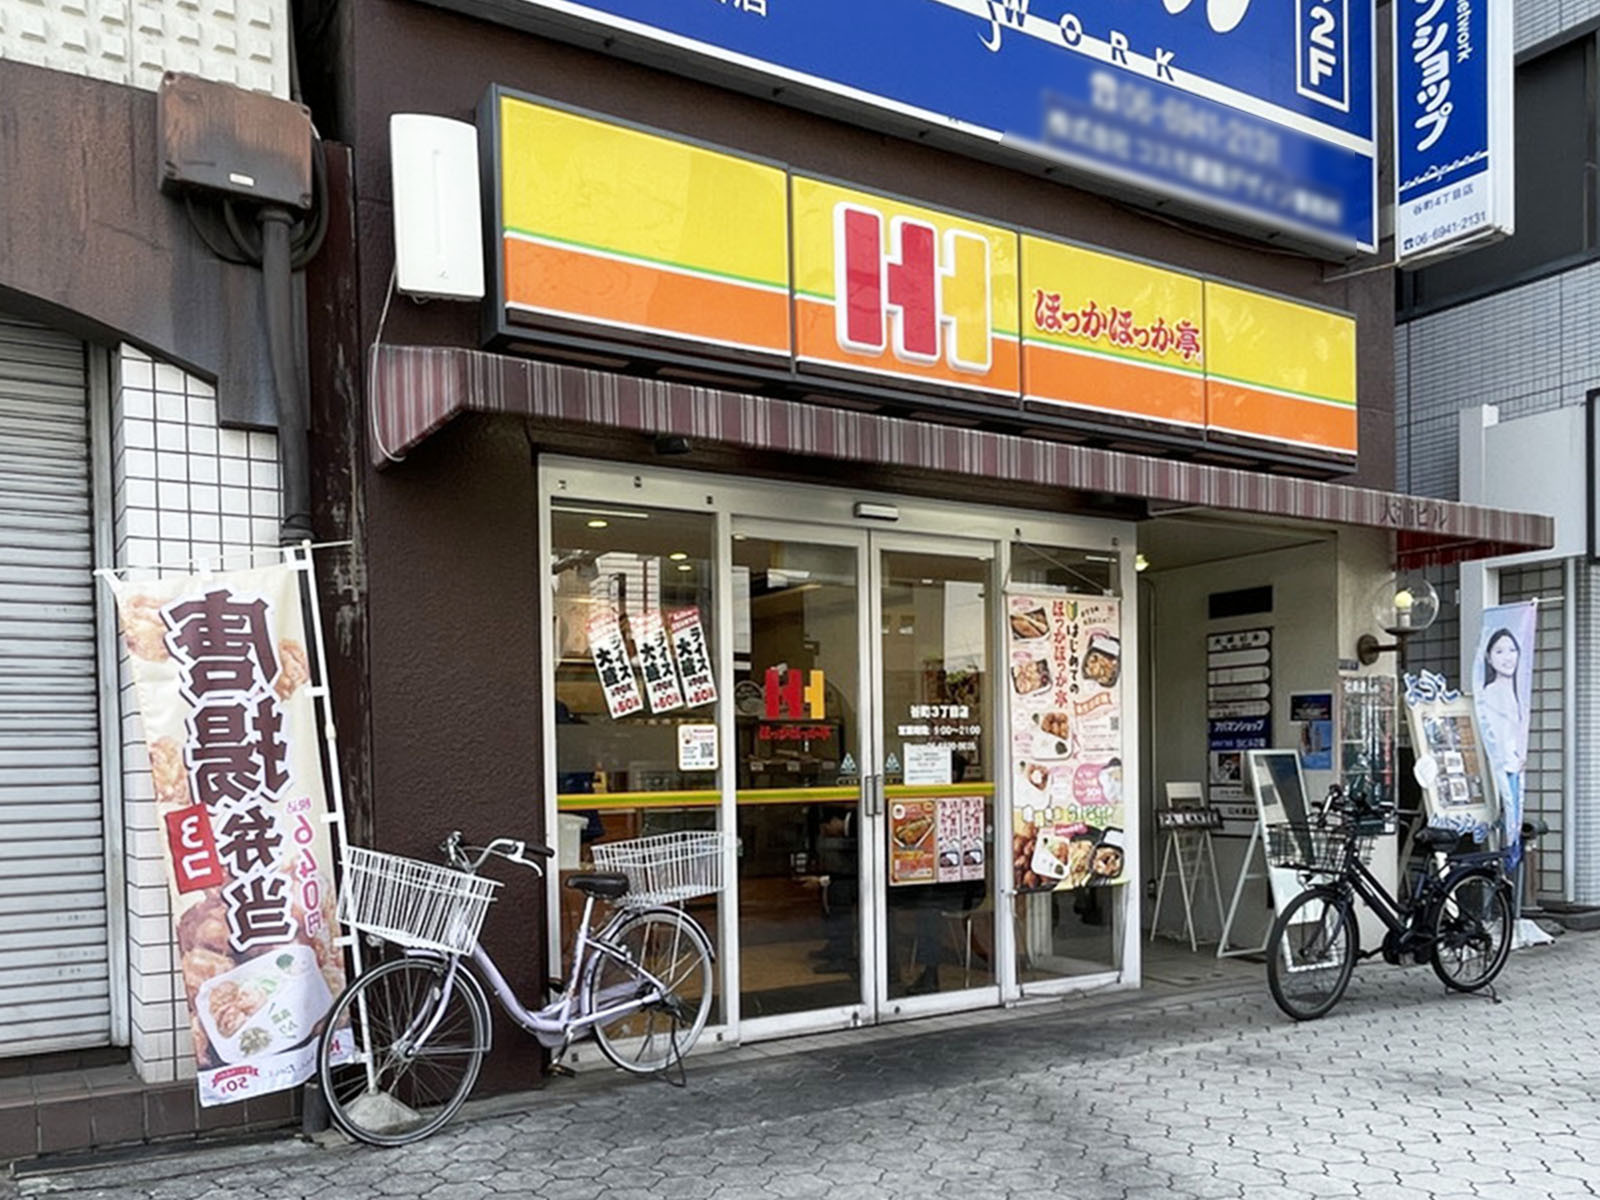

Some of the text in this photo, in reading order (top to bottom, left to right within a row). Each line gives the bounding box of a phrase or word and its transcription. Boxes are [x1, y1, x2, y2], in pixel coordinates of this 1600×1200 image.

[1457, 0, 1473, 63] etwork
[1034, 288, 1201, 361] ほっかほっか亭
